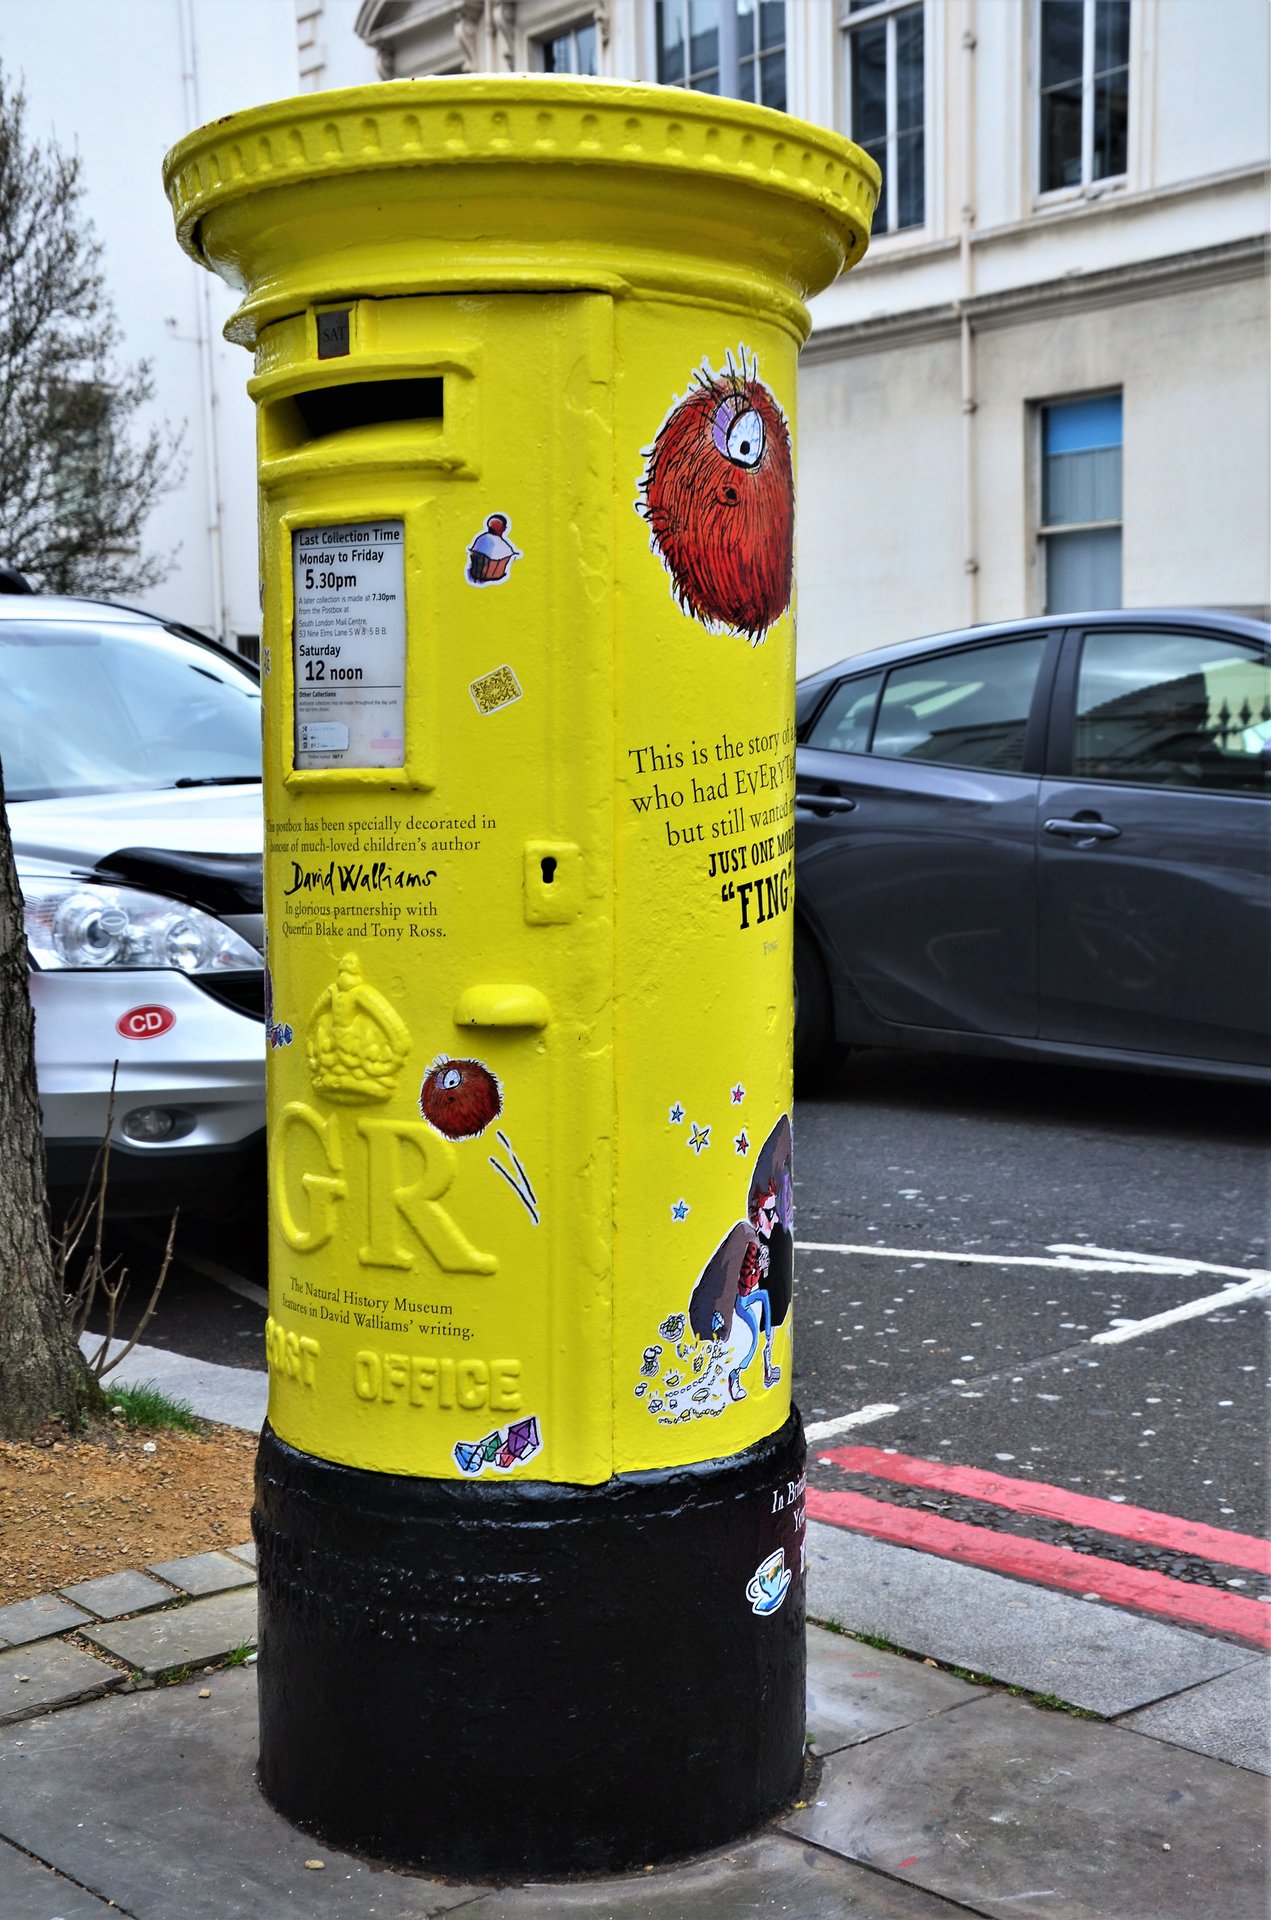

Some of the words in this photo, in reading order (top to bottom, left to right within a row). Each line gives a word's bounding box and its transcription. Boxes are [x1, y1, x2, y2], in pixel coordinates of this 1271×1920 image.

[323, 326, 347, 343] SAT
[299, 533, 319, 546] Last
[321, 530, 370, 545] Collection
[373, 528, 400, 541] Time
[300, 552, 335, 566] Monday
[338, 552, 348, 562] to
[352, 549, 384, 563] Friday
[305, 569, 357, 591] 5.30pm
[316, 595, 340, 604] collection
[372, 593, 396, 602] 7.30pm
[299, 607, 311, 615] from
[322, 606, 342, 614] Postbox
[299, 619, 314, 627] South
[336, 618, 347, 626] Mail
[320, 629, 333, 637] Elms
[300, 645, 341, 658] Saturday
[305, 660, 325, 681] 12
[330, 668, 363, 680] noon
[628, 743, 684, 775] This
[692, 740, 708, 765] is
[715, 734, 744, 762] the
[748, 733, 780, 756] story
[782, 718, 790, 746] of
[630, 784, 684, 813] who
[691, 773, 729, 803] had
[276, 818, 302, 836] postbox
[304, 817, 319, 831] has
[321, 816, 345, 831] been
[348, 815, 402, 834] specially
[406, 815, 476, 830] decorated
[482, 815, 497, 829] in
[665, 821, 705, 847] but
[711, 807, 745, 839] still
[750, 792, 788, 828] wanted
[291, 838, 300, 852] of
[301, 838, 360, 852] much-loved
[363, 837, 427, 852] children’s
[431, 837, 481, 851] author
[709, 846, 747, 878] JUST
[751, 837, 775, 866] ONE
[284, 861, 336, 896] David
[337, 862, 438, 892] Walliams
[285, 902, 294, 916] In
[294, 902, 331, 918] glorious
[333, 902, 402, 920] partnership
[406, 902, 438, 916] with
[282, 922, 313, 938] Quentin
[315, 923, 344, 937] Blake
[346, 923, 368, 937] and
[371, 923, 404, 941] Tony
[409, 924, 447, 938] Ross.
[129, 1012, 163, 1033] CD
[271, 1101, 499, 1276] GR
[290, 1276, 304, 1294] The
[305, 1282, 340, 1303] Natural
[344, 1291, 389, 1313] History
[393, 1297, 453, 1315] Museum
[282, 1293, 307, 1315] features
[309, 1302, 318, 1318] in
[320, 1305, 350, 1325] David
[353, 1312, 414, 1333] Walliams’
[418, 1321, 475, 1342] writing.
[353, 1350, 523, 1412] OFFICE
[771, 1490, 785, 1514] In
